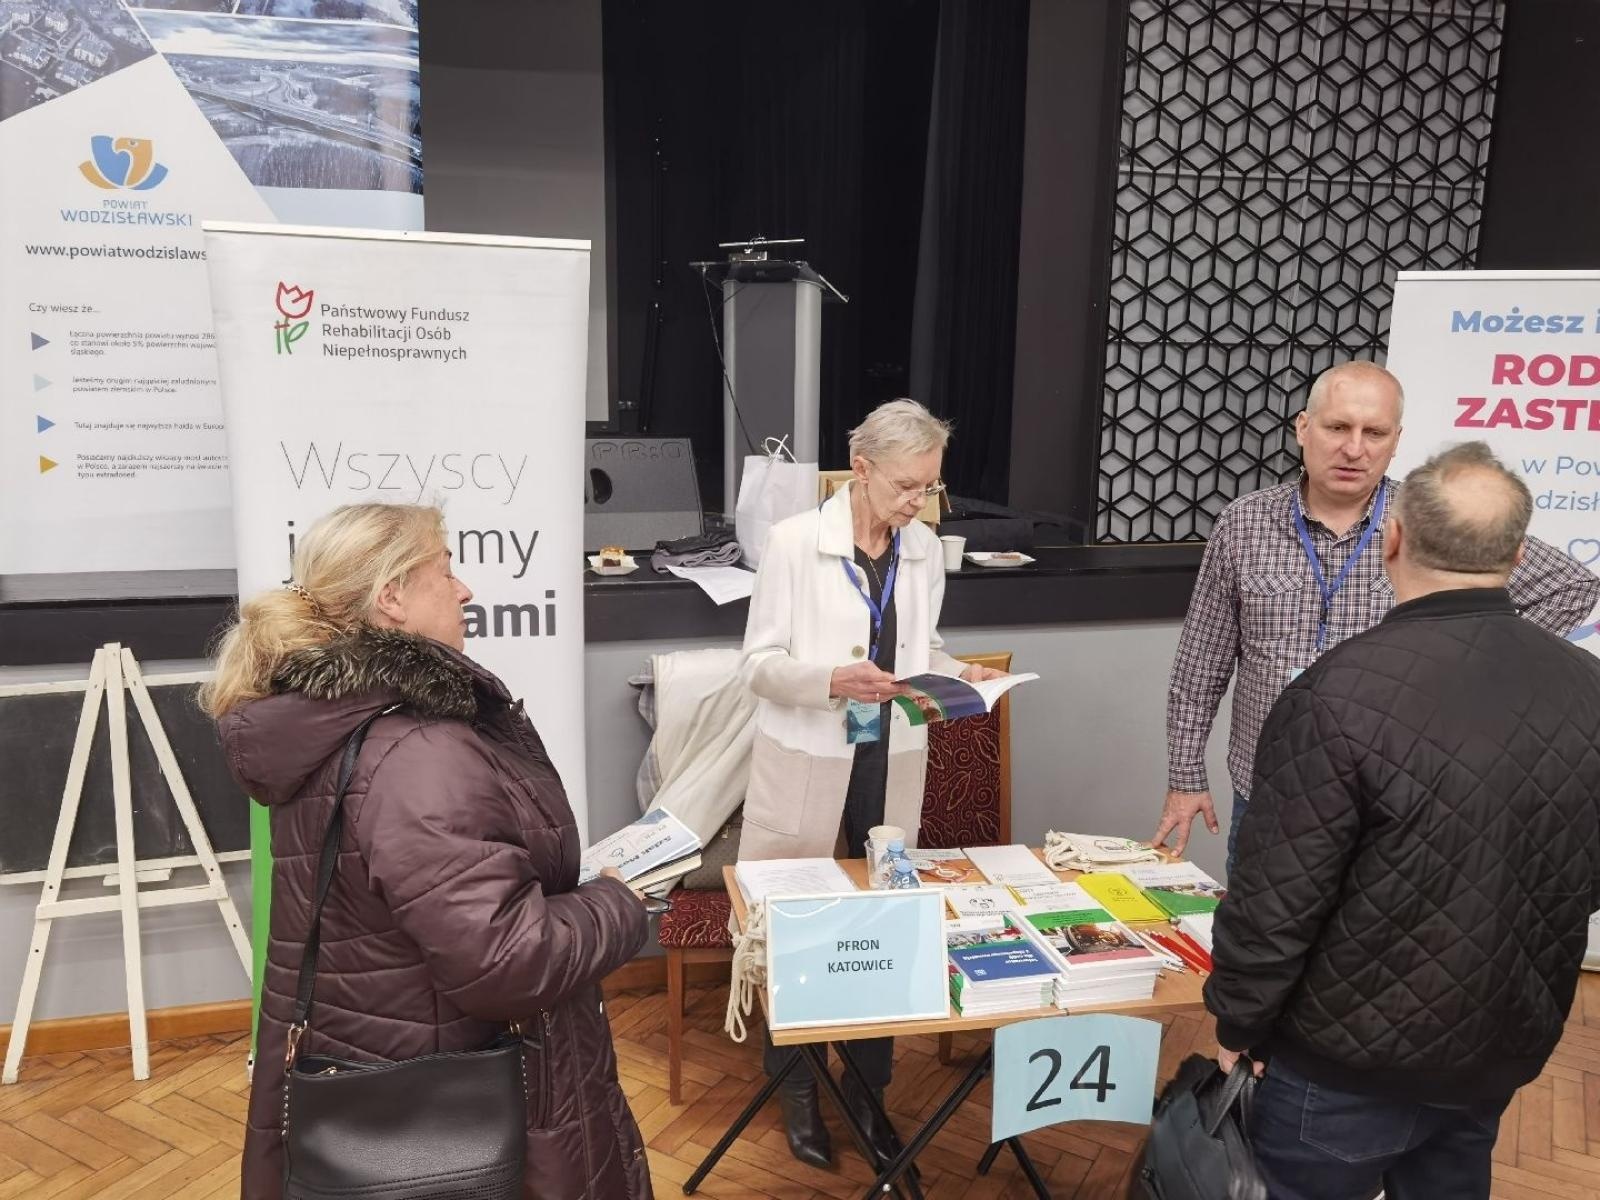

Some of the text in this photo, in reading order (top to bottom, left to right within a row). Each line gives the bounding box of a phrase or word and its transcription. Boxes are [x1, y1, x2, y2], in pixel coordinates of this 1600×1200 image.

[102, 199, 148, 210] POWIAT
[60, 209, 192, 226] WODZISŁAWSKI
[29, 303, 47, 314] Czy
[50, 303, 78, 313] wiesz
[320, 303, 470, 323] Państwowy Fundusz
[1451, 306, 1585, 334] Możesz
[322, 323, 452, 343] Rehabilitacji Osób
[322, 343, 467, 363] Niepełnosprawnych
[279, 440, 528, 505] Wszyscy
[1521, 458, 1548, 475] w
[1535, 489, 1600, 512] dzisł
[837, 939, 880, 952] PFRON
[828, 958, 894, 974] KATOWICE
[1026, 1045, 1117, 1112] 24
